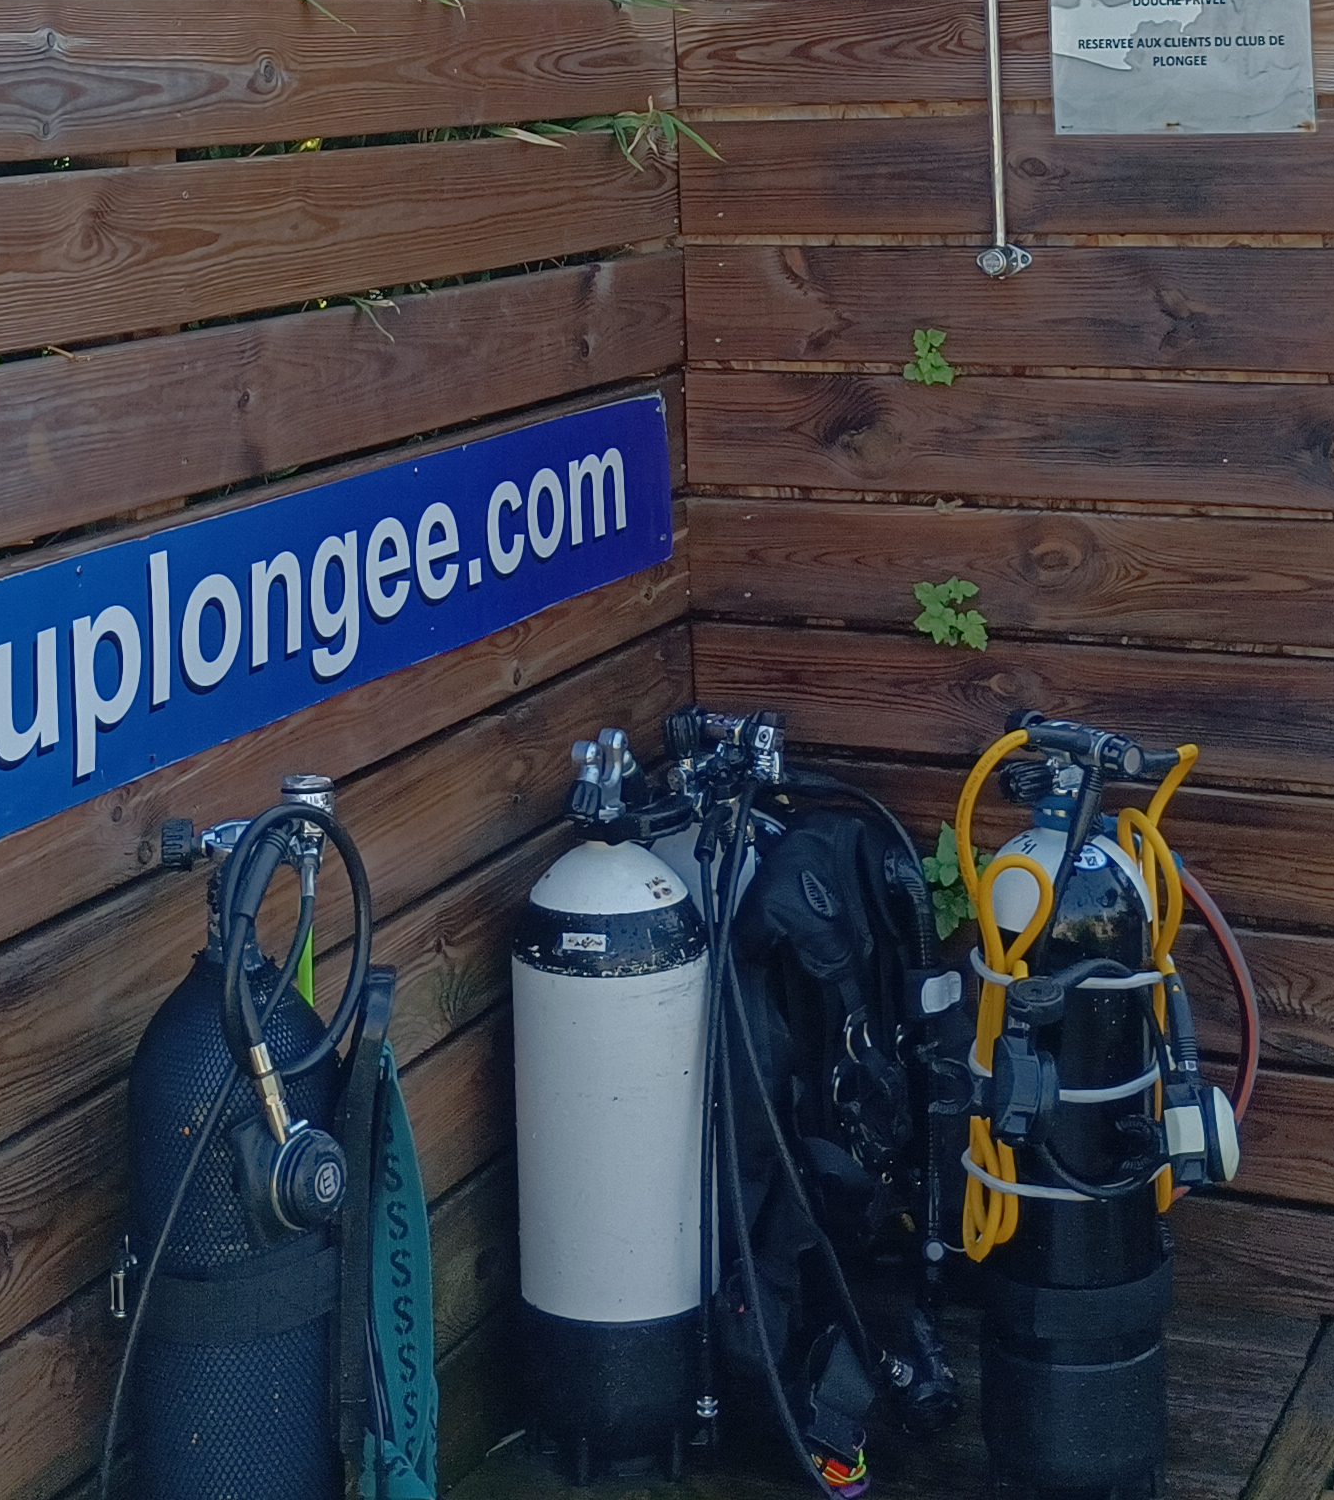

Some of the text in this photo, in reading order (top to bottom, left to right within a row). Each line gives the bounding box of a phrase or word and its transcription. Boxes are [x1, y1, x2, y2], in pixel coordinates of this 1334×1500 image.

[1077, 34, 1285, 50] RESERVEE AUX CLIENTS DU CLUB DE
[1152, 55, 1208, 68] PLONGEE
